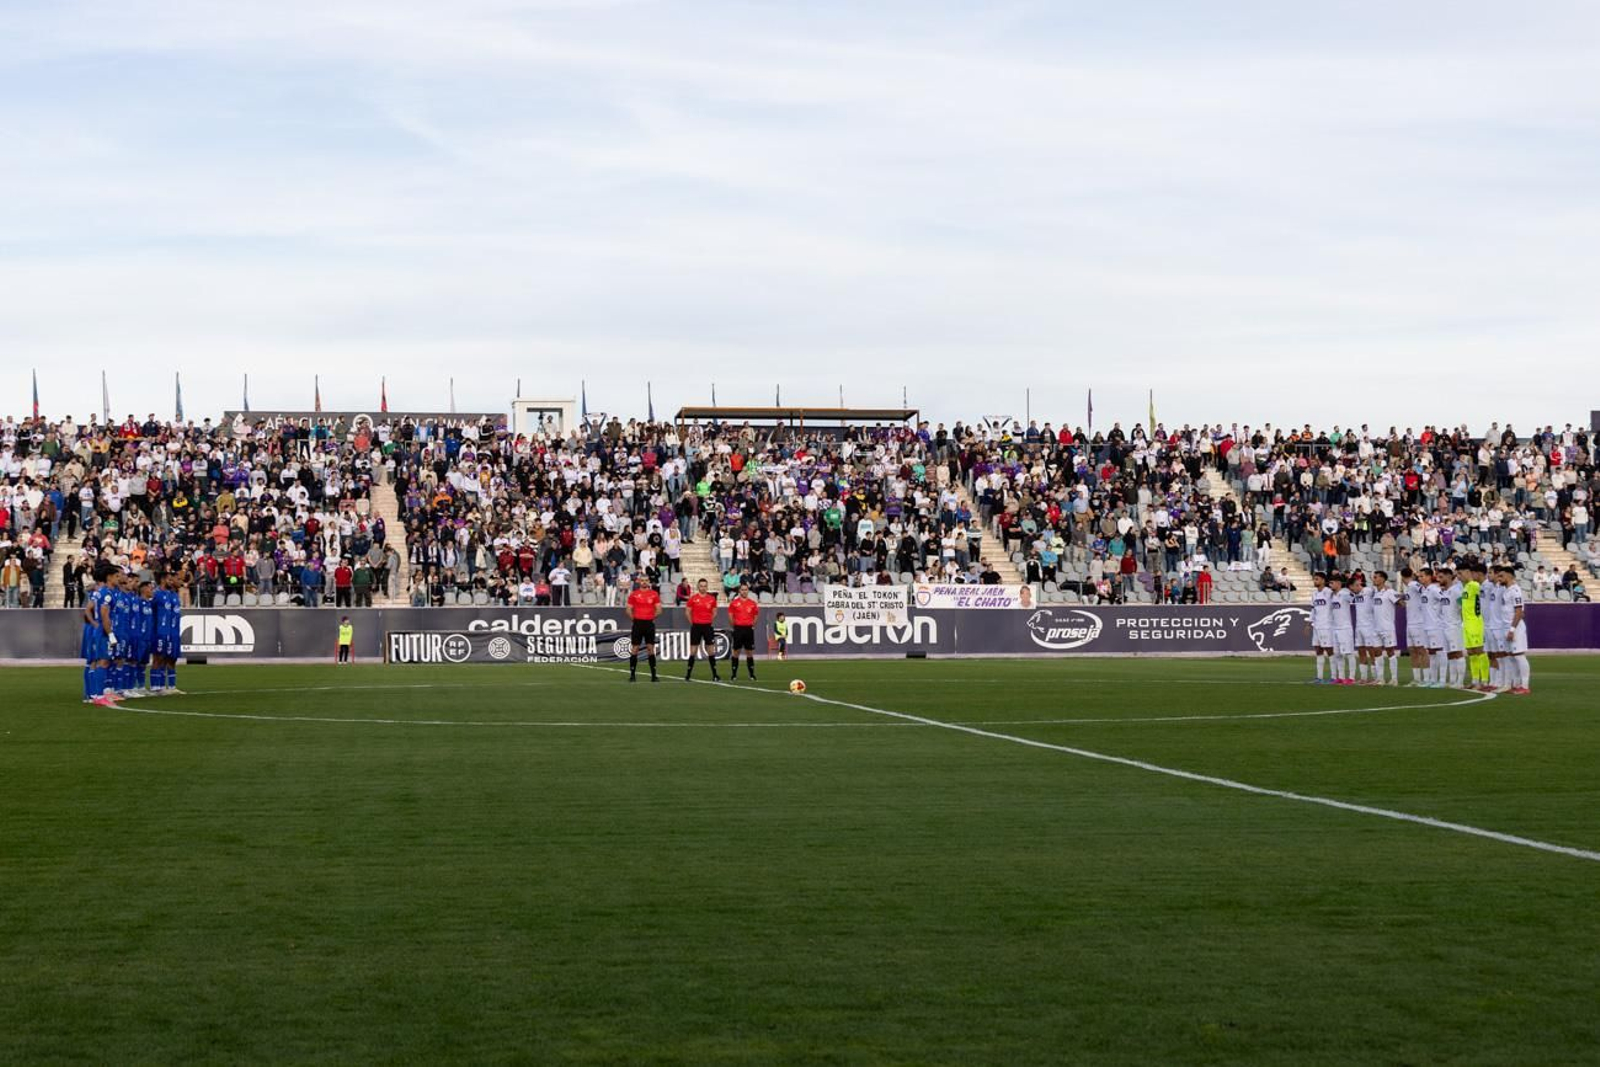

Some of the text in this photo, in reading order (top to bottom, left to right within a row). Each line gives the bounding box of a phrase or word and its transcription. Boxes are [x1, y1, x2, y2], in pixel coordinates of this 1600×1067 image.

[832, 588, 853, 599] PEÑA
[959, 586, 980, 596] REAL
[826, 601, 850, 609] CABRA
[851, 601, 865, 610] DEL
[880, 600, 904, 609] CRISTO
[468, 613, 618, 635] calderón
[1116, 617, 1240, 628] PROTECCION Y
[1045, 624, 1101, 642] proseja
[1128, 629, 1227, 640] SEGURIDAD
[527, 635, 598, 654] SEGUNDA
[653, 631, 702, 660] FUTU
[527, 655, 598, 663] FEDERACIÓN
